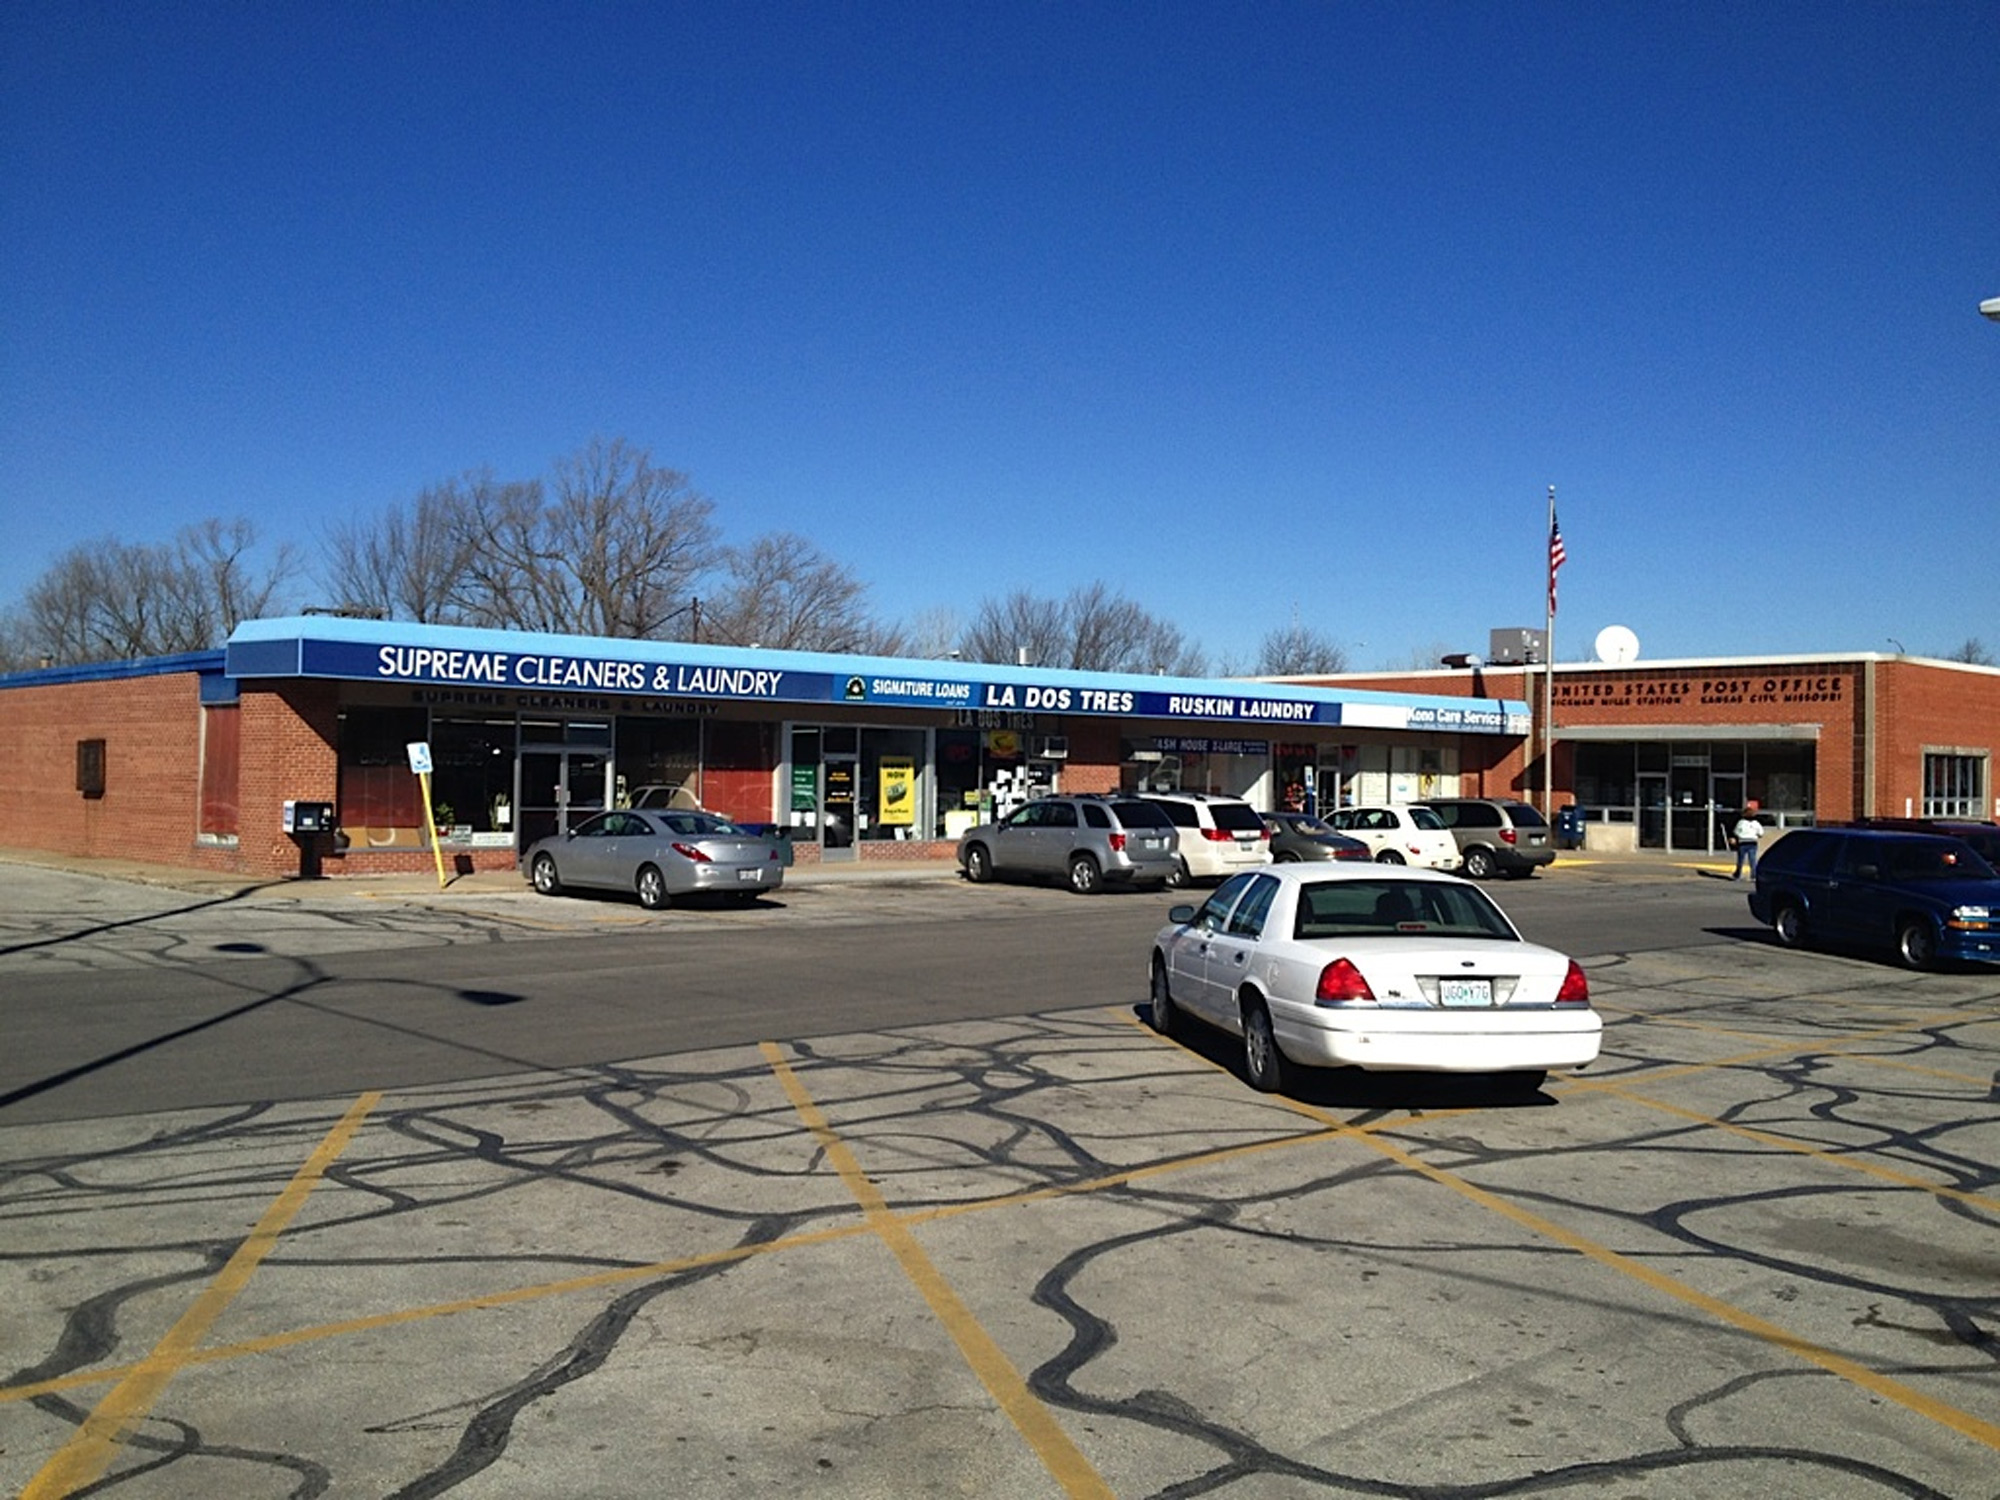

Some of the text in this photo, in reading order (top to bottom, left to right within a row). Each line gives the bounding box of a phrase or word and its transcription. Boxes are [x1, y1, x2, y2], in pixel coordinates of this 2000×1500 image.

[378, 646, 783, 696] SUPREME CLEANERS & LAUNDRY
[872, 679, 934, 697] SIGNATURE
[935, 683, 970, 699] LOANS
[1625, 682, 1690, 696] STATES
[1703, 681, 1751, 694] POST
[1763, 677, 1841, 692] OFFICE
[412, 690, 505, 706] SUPREME
[517, 695, 610, 710] CLEANERS
[643, 701, 719, 715] LAUNDRY
[986, 685, 1134, 712] LA DOS TRES
[1637, 696, 1681, 705] STATION
[1784, 692, 1841, 702] MISSOURI
[1169, 696, 1314, 720] RUSKIN LAUNDRY
[1437, 708, 1461, 724] Care
